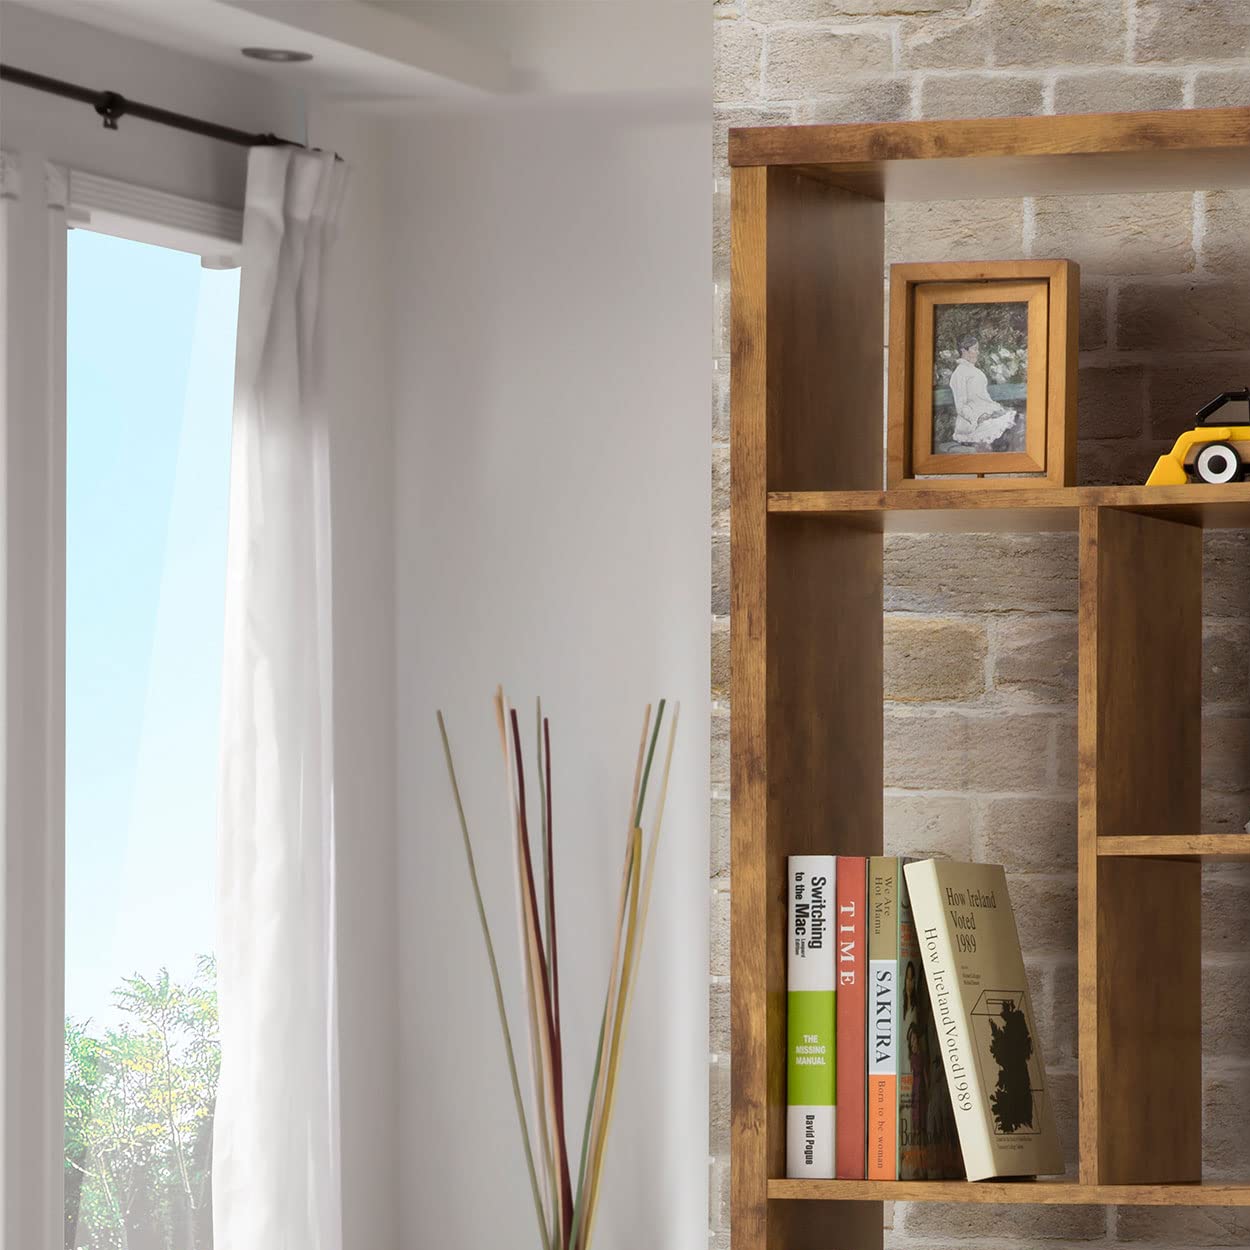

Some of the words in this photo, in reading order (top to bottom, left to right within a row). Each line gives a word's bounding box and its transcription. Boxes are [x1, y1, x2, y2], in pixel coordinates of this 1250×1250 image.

[795, 871, 805, 882] to
[875, 877, 883, 896] Hot
[884, 876, 893, 894] We
[795, 884, 806, 900] the
[945, 887, 966, 906] How
[967, 888, 997, 909] Ireland
[808, 876, 827, 949] Switching
[884, 900, 892, 916] Are
[795, 903, 810, 936] Mac
[875, 902, 883, 935] Mama
[950, 910, 977, 930] Voted
[840, 901, 855, 985] TIME
[924, 927, 939, 964] How
[955, 933, 977, 953] 1989
[876, 970, 892, 1064] SAKURA
[803, 1034, 819, 1043] THE
[795, 1045, 827, 1054] MISSING
[795, 1056, 827, 1065] MANUAL
[878, 1080, 886, 1103] Born
[878, 1107, 884, 1117] to
[805, 1114, 815, 1138] David
[878, 1120, 885, 1132] be
[804, 1139, 815, 1165] Pogue
